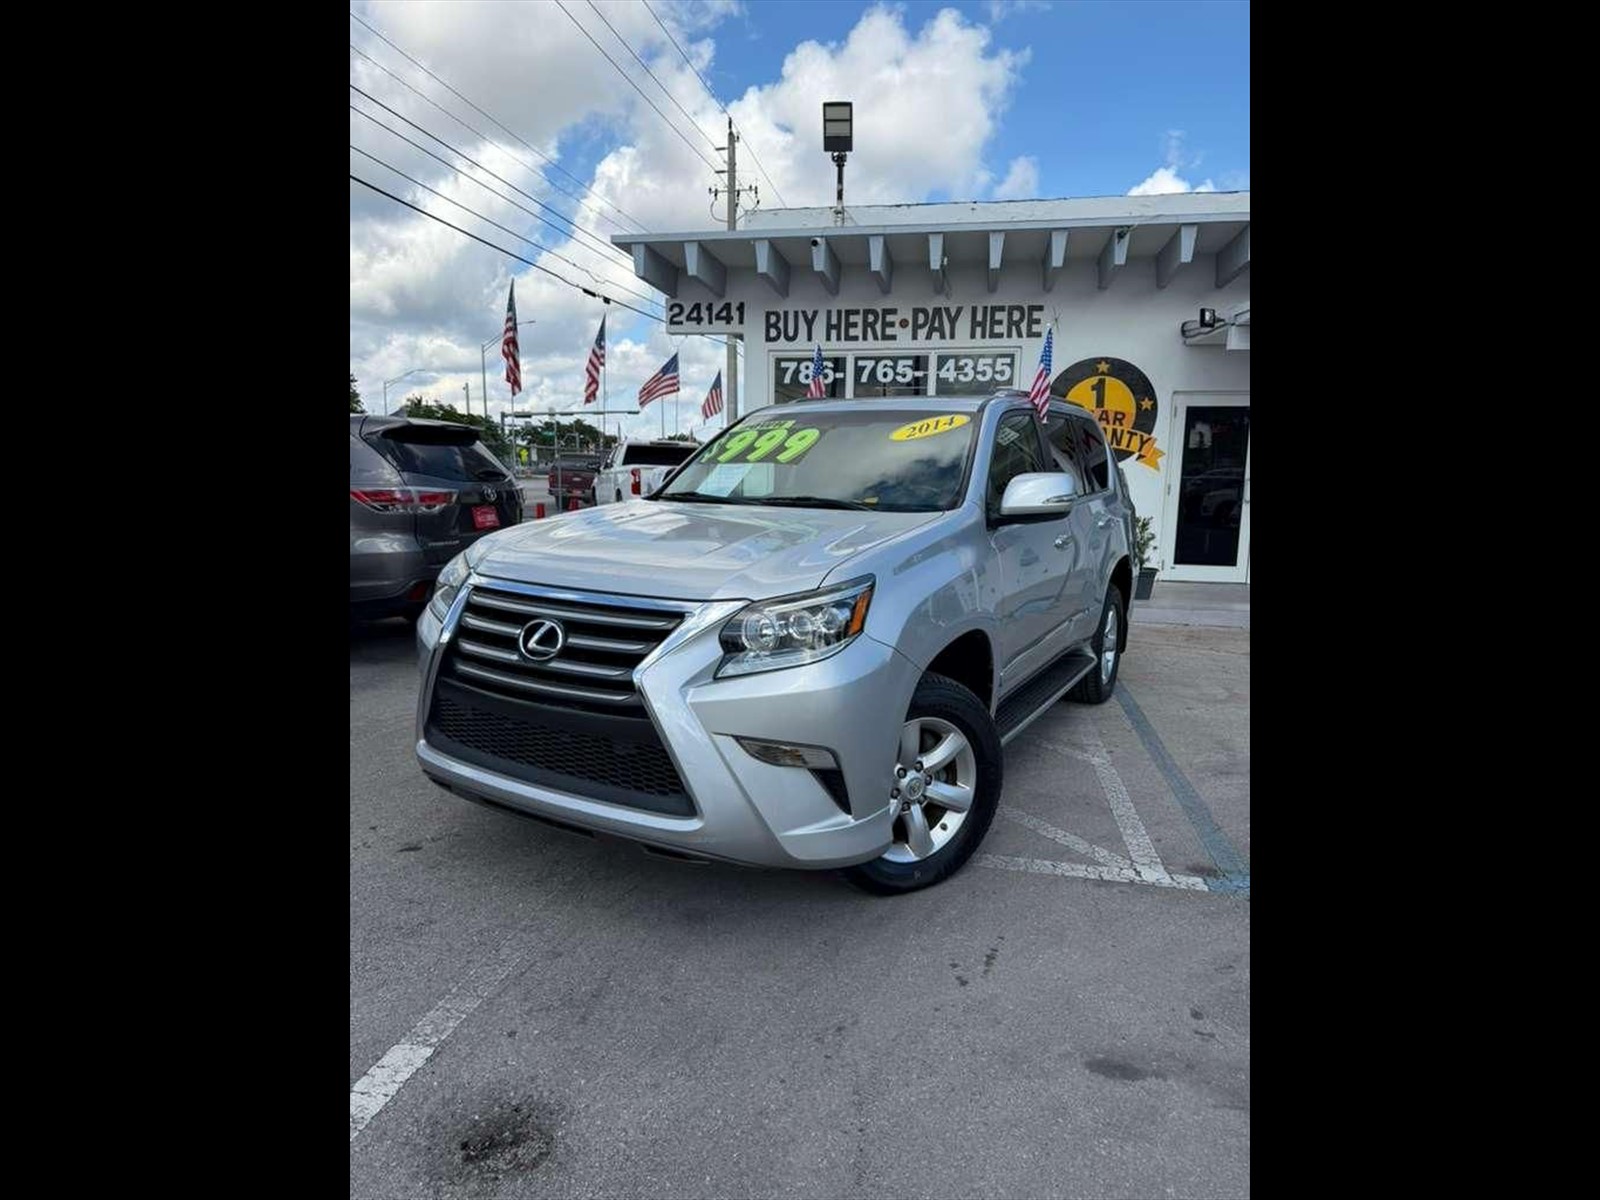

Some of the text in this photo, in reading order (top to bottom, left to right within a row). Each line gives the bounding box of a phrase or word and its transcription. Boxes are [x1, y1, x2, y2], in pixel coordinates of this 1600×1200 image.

[669, 302, 745, 326] 24141
[764, 304, 1044, 343] BUY HERE PAY HERE
[857, 359, 924, 384] 765-
[939, 357, 1012, 383] 4355
[1091, 377, 1106, 409] 1
[906, 415, 956, 438] 2014
[1093, 409, 1126, 427] AR
